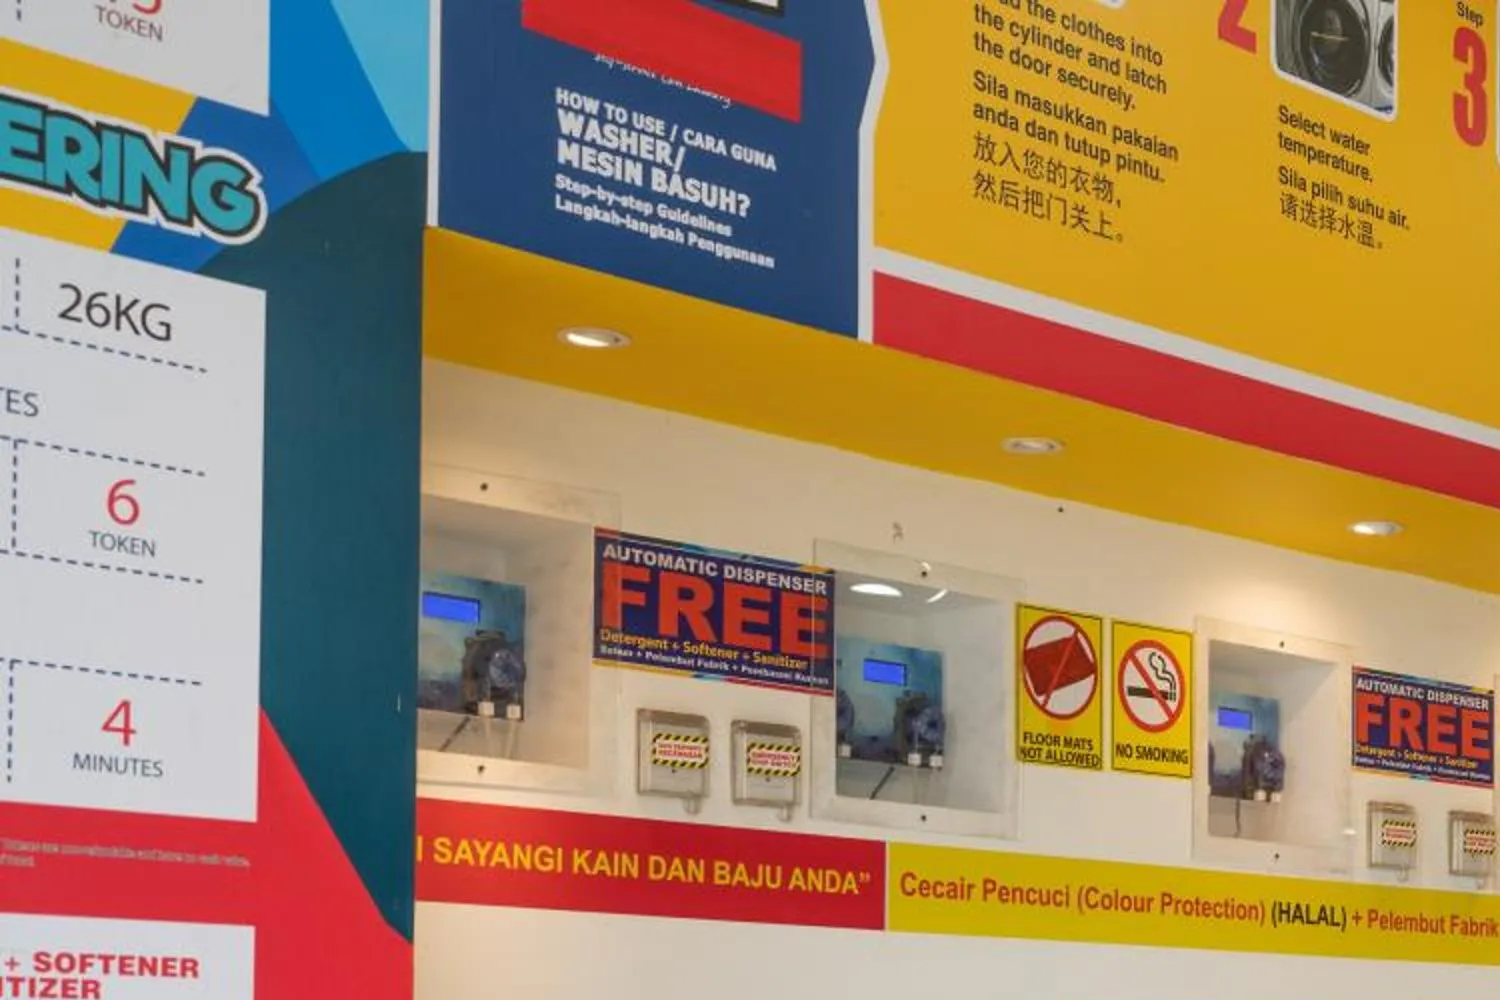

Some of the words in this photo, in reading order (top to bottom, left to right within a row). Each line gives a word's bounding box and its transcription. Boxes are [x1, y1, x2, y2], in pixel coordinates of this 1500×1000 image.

[97, 6, 164, 41] TOKEN
[1027, 0, 1056, 23] the
[1061, 14, 1125, 51] clothes
[1130, 36, 1163, 66] into
[1456, 2, 1484, 28] Step
[974, 4, 1004, 31] the
[1009, 20, 1082, 60] cylinder
[1088, 51, 1120, 76] and
[1126, 62, 1167, 95] latch
[974, 32, 1004, 59] the
[1009, 47, 1052, 77] door
[1057, 66, 1135, 112] securely.
[1452, 27, 1488, 147] 3
[555, 87, 599, 115] HOW
[603, 102, 627, 123] TO
[632, 111, 665, 136] USE
[683, 129, 726, 156] CARA
[730, 143, 777, 171] GUNA
[557, 108, 686, 172] WASHER/
[973, 70, 1009, 100] Sila
[1015, 89, 1107, 135] masukkan
[1112, 124, 1179, 161] pakaian
[1279, 105, 1325, 138] Select
[1330, 129, 1370, 156] water
[973, 103, 1019, 132] anda
[1025, 119, 1059, 147] dan
[1064, 131, 1111, 167] tutup
[1116, 152, 1165, 184] pintu.
[1279, 132, 1373, 182] temperature.
[557, 138, 643, 186] MESIN
[651, 166, 751, 217] BASUH?
[1279, 166, 1307, 192] Sila
[1311, 179, 1343, 204] pilih
[1348, 194, 1384, 219] suhu
[1388, 208, 1410, 230] air.
[555, 174, 653, 216] Step-by-step
[657, 204, 733, 236] Guidelines
[555, 194, 684, 244] Langkah-langkah
[687, 231, 775, 268] Penggunaan
[58, 283, 172, 342] 26KG
[0, 388, 39, 417] ES
[106, 480, 140, 525] 6
[88, 530, 156, 557] TOKEN
[602, 543, 718, 577] AUTOMATIC
[723, 565, 828, 595] DISPENSER
[602, 562, 830, 658] FREE
[683, 641, 738, 660] Softener
[1356, 678, 1425, 699] AUTOMATIC
[1427, 690, 1489, 711] DISPENSER
[101, 700, 136, 745] 4
[1024, 732, 1060, 747] FLOOR
[1064, 736, 1093, 751] MATS
[1356, 693, 1490, 759] FREE
[72, 752, 163, 778] MINUTES
[1020, 746, 1042, 759] NOT
[1045, 748, 1100, 768] ALLOWED
[1116, 743, 1133, 758] NO
[1136, 746, 1188, 765] SMOKING
[434, 837, 563, 873] SAYANGI
[572, 849, 640, 879] KAIN
[648, 855, 705, 883] DAN
[714, 861, 782, 889] BAJU
[900, 871, 976, 901] Cecair
[982, 877, 1070, 908] Pencuci
[1077, 885, 1154, 915] (Colour
[1160, 892, 1266, 926] Protection)
[1271, 900, 1347, 932] (HALAL)
[1352, 911, 1363, 927] +
[1367, 908, 1446, 935] Pelembut
[1450, 914, 1499, 938] Fabrik
[4, 956, 20, 971] +
[33, 951, 200, 979] SOFTENER
